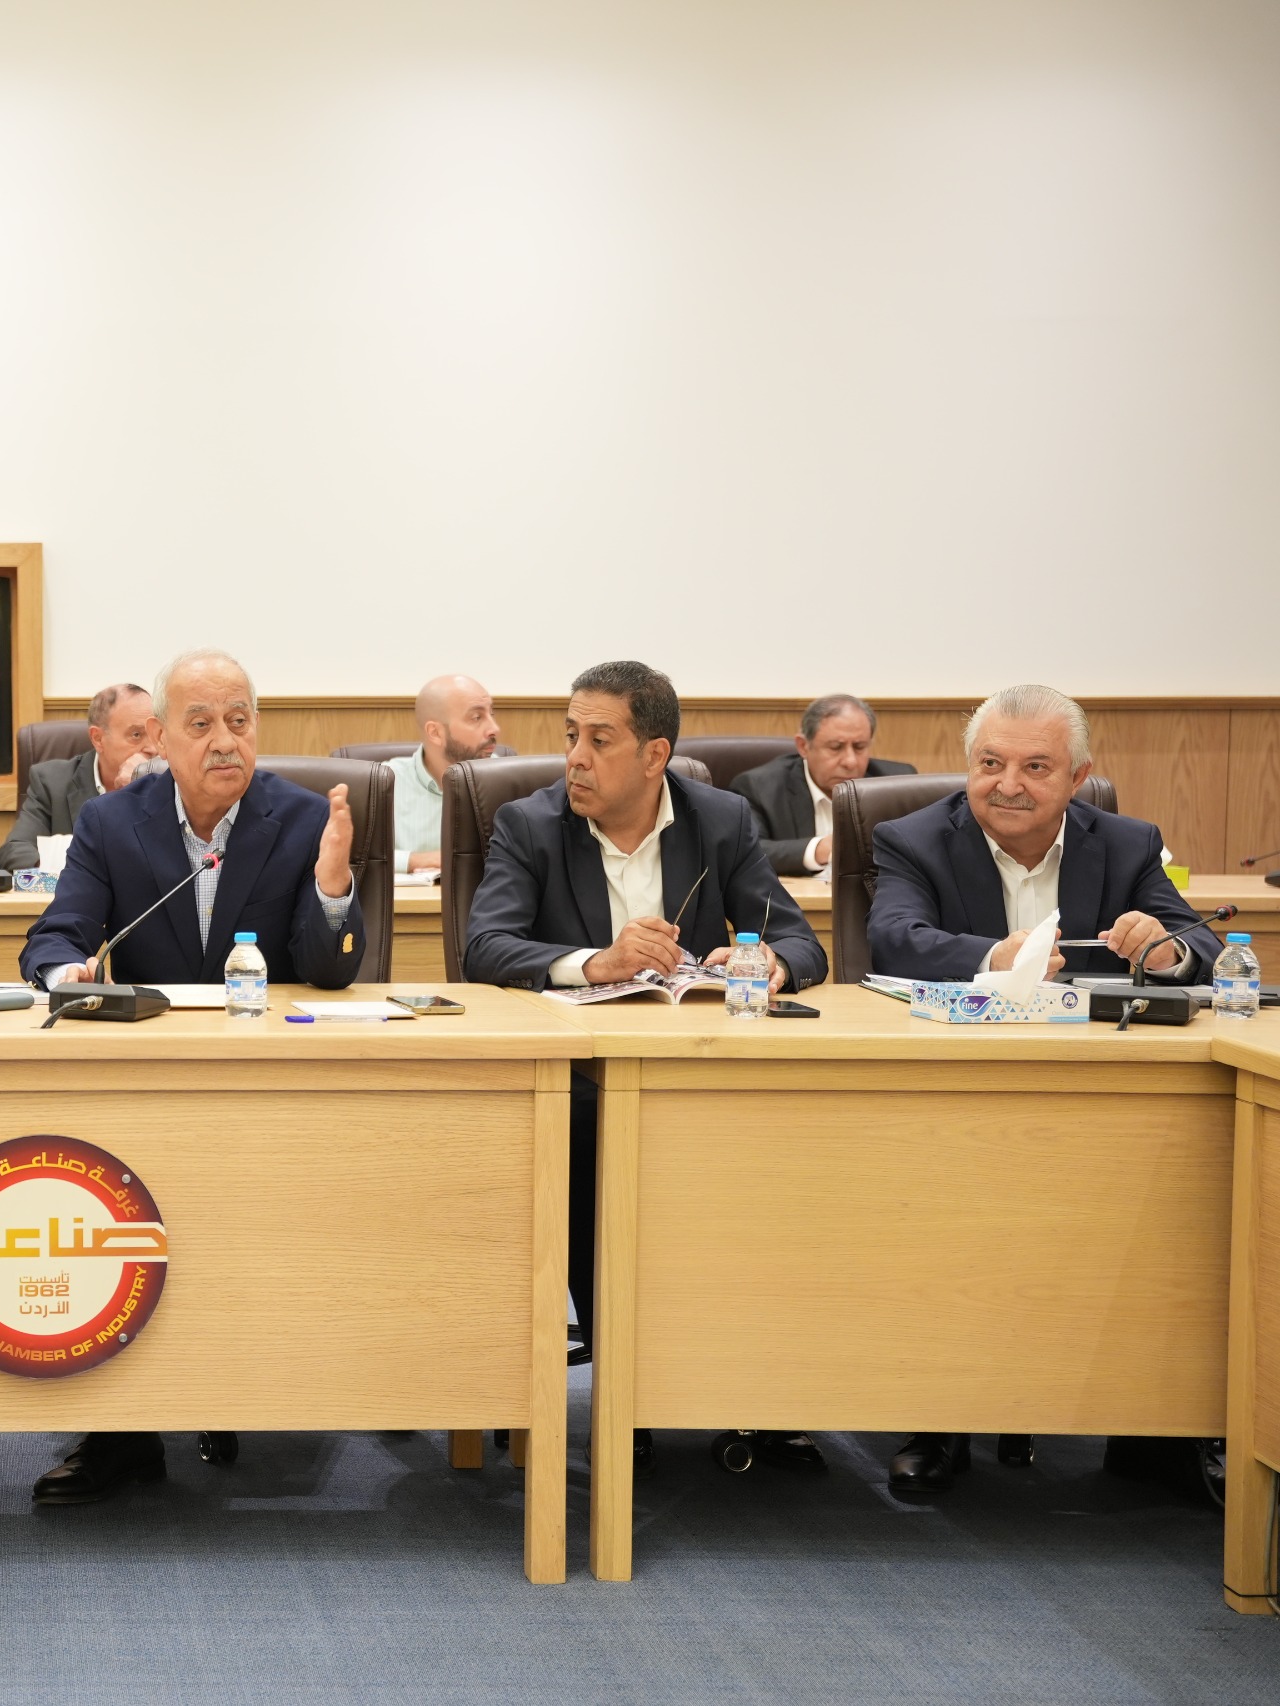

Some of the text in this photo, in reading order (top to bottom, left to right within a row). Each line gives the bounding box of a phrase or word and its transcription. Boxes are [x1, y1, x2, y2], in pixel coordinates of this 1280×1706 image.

[0, 1151, 86, 1176] صناعة
[19, 1284, 70, 1297] 1962
[70, 1339, 94, 1357] OF
[96, 1265, 147, 1344] INDUSTRY
